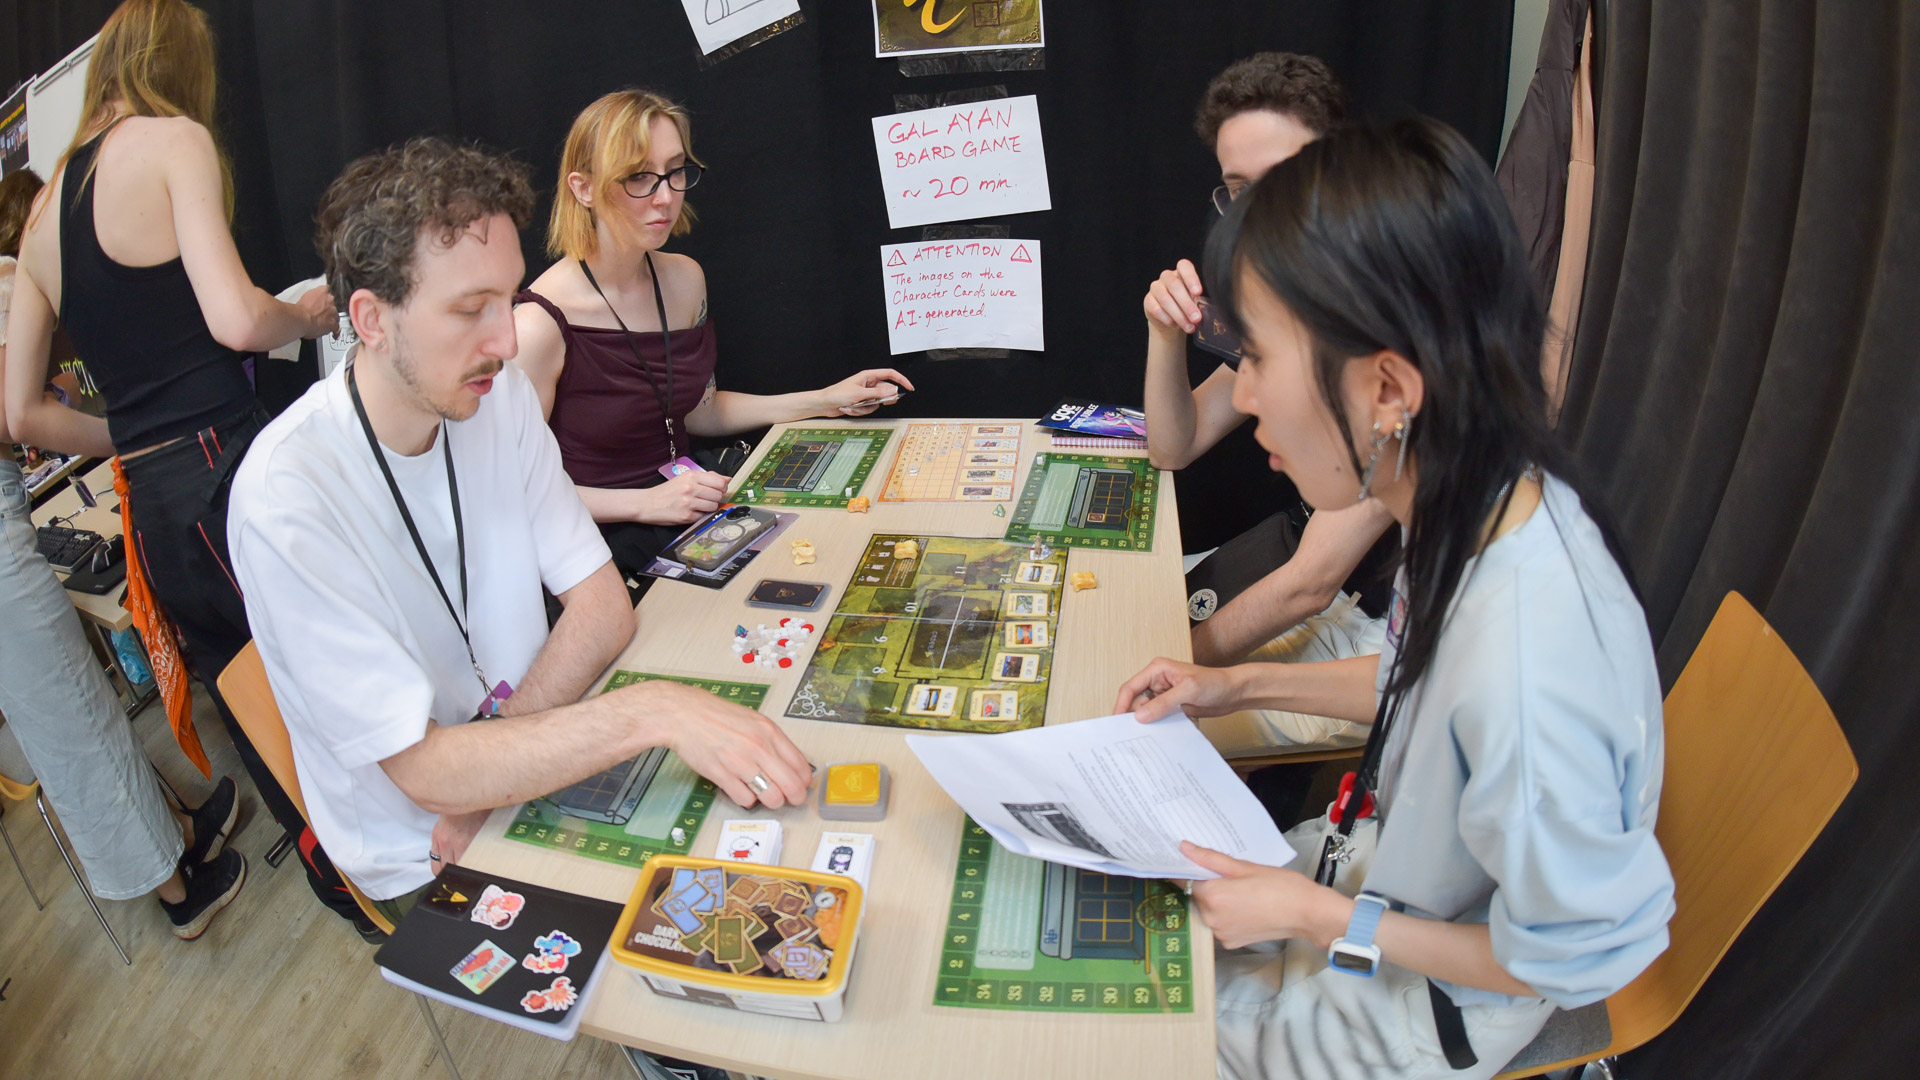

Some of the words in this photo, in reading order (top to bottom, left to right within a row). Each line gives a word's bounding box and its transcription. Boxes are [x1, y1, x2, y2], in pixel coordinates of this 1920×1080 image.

[888, 120, 938, 143] GAL
[947, 104, 1012, 134] AYAN
[895, 146, 955, 168] BOARD
[961, 135, 1022, 157] GAME
[929, 176, 969, 198] 20
[912, 243, 1002, 262] ATTENTION
[891, 273, 912, 285] The
[919, 271, 954, 287] images
[961, 271, 973, 279] on
[980, 267, 1005, 279] the
[893, 289, 948, 305] Character
[953, 283, 986, 298] Cards
[990, 289, 1017, 297] were
[954, 566, 967, 575] 11
[1000, 573, 1012, 584] 12
[904, 602, 918, 612] 10
[874, 635, 888, 644] 9
[872, 666, 887, 674] 8
[728, 686, 740, 696] 34
[884, 706, 898, 714] 7
[692, 800, 704, 808] 8
[684, 818, 696, 826] 9
[536, 828, 547, 838] 17
[574, 837, 588, 848] 15
[597, 842, 609, 852] 14
[618, 846, 632, 858] 13
[640, 850, 652, 862] 12
[964, 868, 978, 876] 6
[962, 890, 975, 899] 5
[958, 912, 971, 921] 4
[1165, 914, 1180, 929] 25
[652, 924, 680, 940] DARK
[634, 931, 690, 953] CHOCOLA
[954, 935, 968, 944] 3
[1166, 936, 1180, 952] 26
[949, 959, 964, 968] 2
[1167, 962, 1182, 978] 27
[976, 983, 992, 1000] 34
[1007, 984, 1023, 1001] 33
[1038, 986, 1054, 1002] 32
[1070, 988, 1086, 1002] 31
[1103, 986, 1118, 1004] 30
[1134, 986, 1150, 1004] 29
[1168, 986, 1182, 1004] 28
